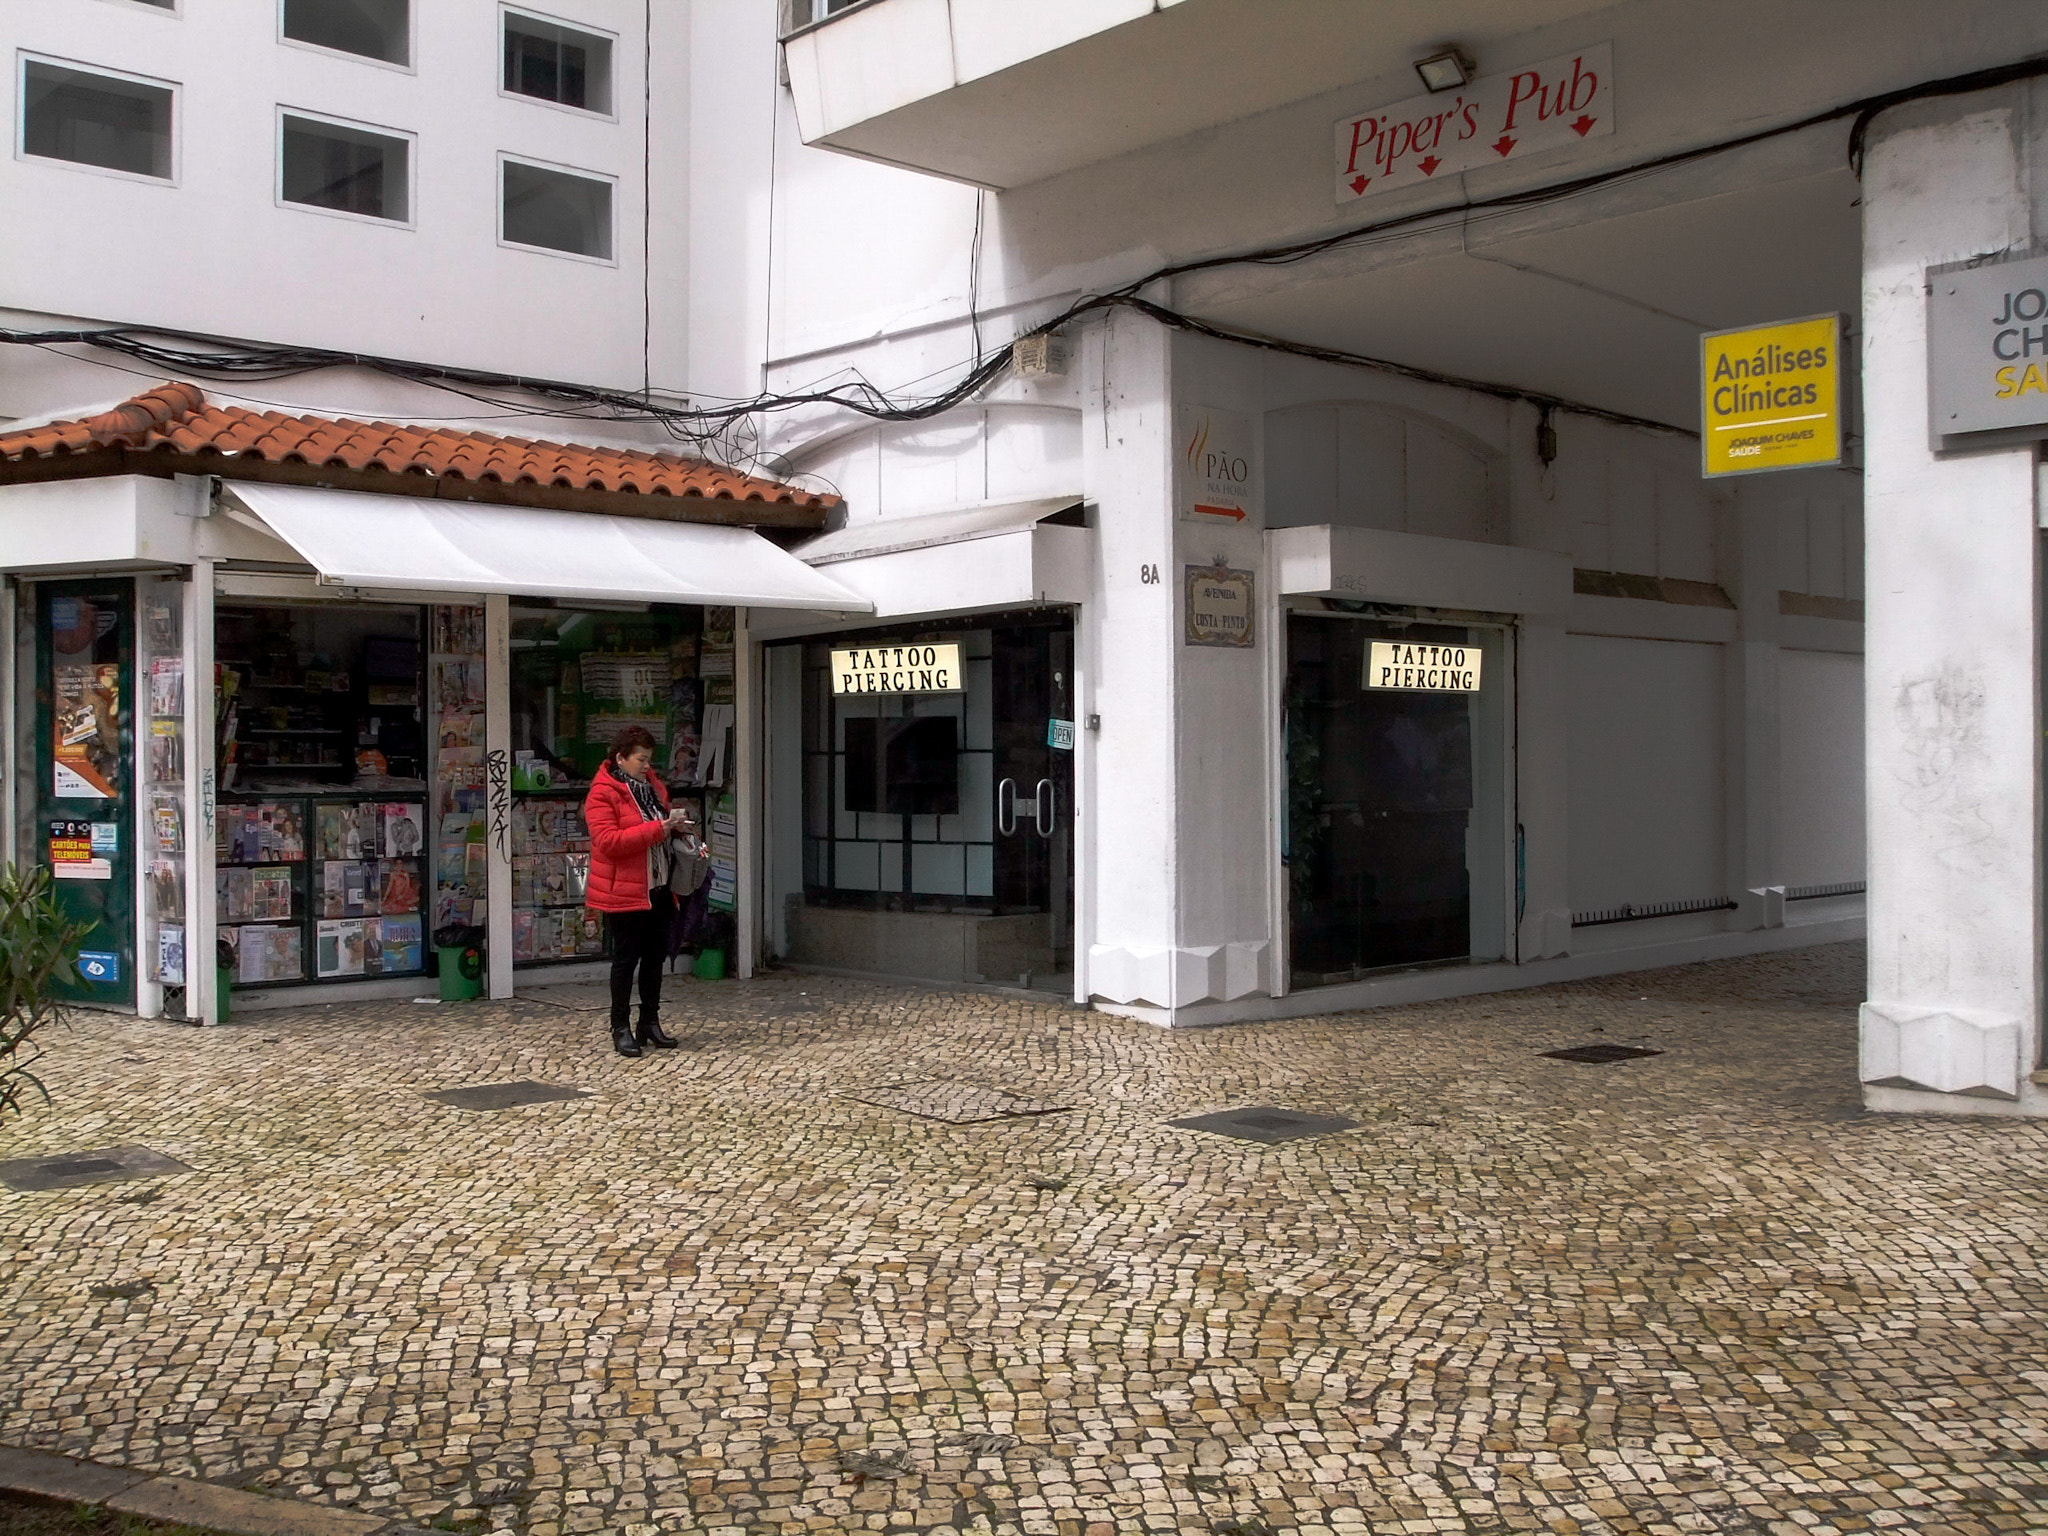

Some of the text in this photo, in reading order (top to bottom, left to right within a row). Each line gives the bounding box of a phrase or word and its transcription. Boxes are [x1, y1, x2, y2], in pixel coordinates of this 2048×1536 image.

[1343, 56, 1597, 177] Piper's Pub
[1993, 288, 2048, 325] JO
[1713, 344, 1827, 382] Análises
[1995, 362, 2048, 398] SA
[1713, 381, 1817, 416] Clínicas
[1728, 434, 1773, 449] JOAQUIM
[1775, 429, 1814, 443] CHAVES
[1206, 451, 1247, 482] PÃO
[1207, 483, 1248, 498] NA HORA
[1140, 564, 1160, 584] 8A
[1203, 588, 1237, 600] AVENIDA
[1196, 614, 1245, 629] COSTA PINTO
[849, 647, 936, 670] TATTOO
[1391, 645, 1465, 667] TATTOO
[842, 669, 949, 693] PIERCING
[1381, 666, 1473, 690] PIERCING
[1052, 727, 1072, 742] OPEN
